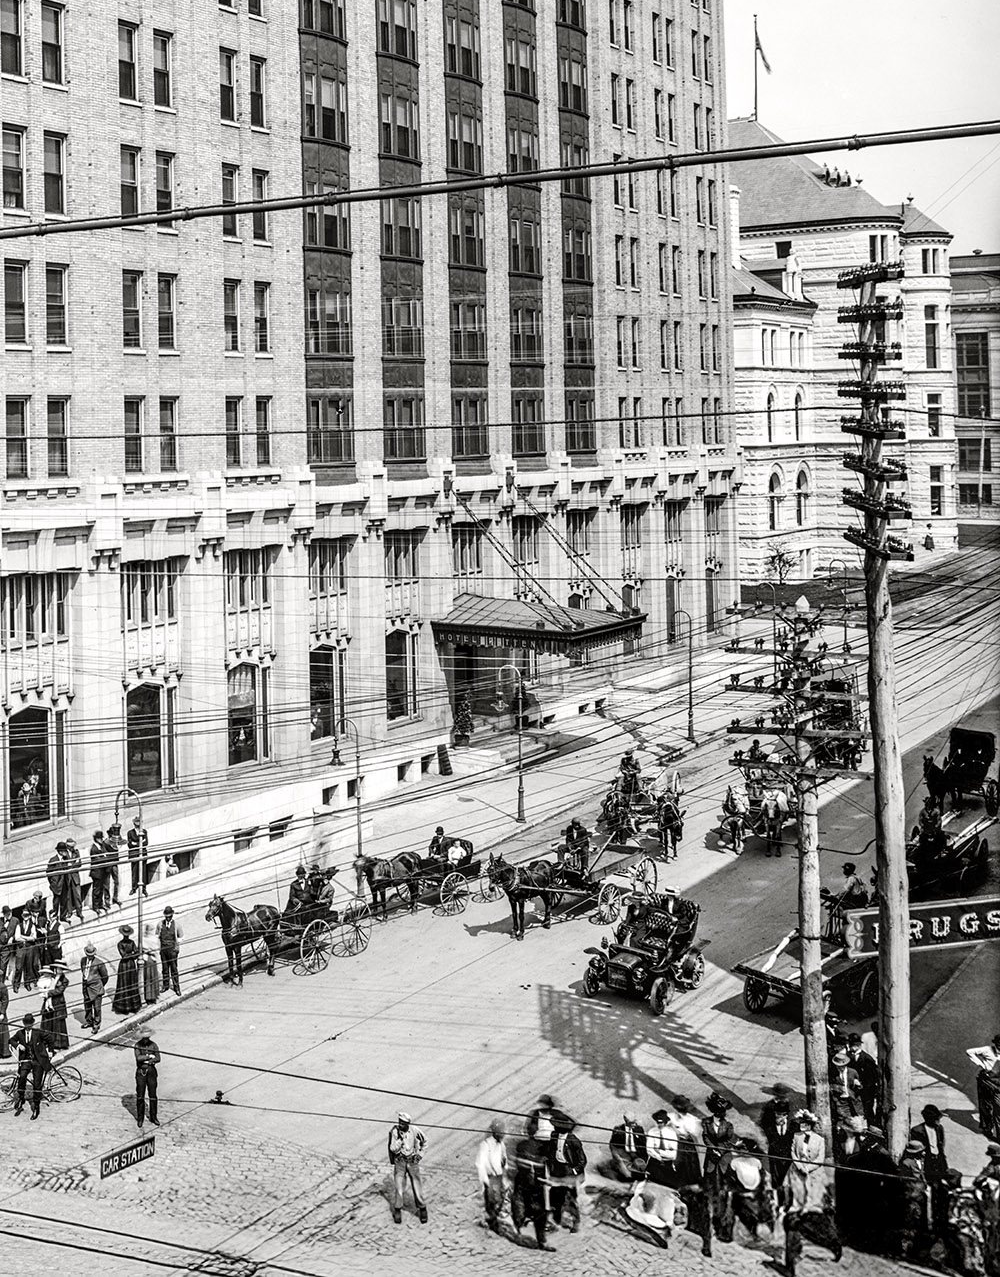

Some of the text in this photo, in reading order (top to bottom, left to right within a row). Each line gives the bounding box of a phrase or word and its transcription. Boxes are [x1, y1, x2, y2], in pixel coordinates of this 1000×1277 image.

[439, 633, 477, 643] HOTEL
[102, 1141, 154, 1175] CAR STATION
